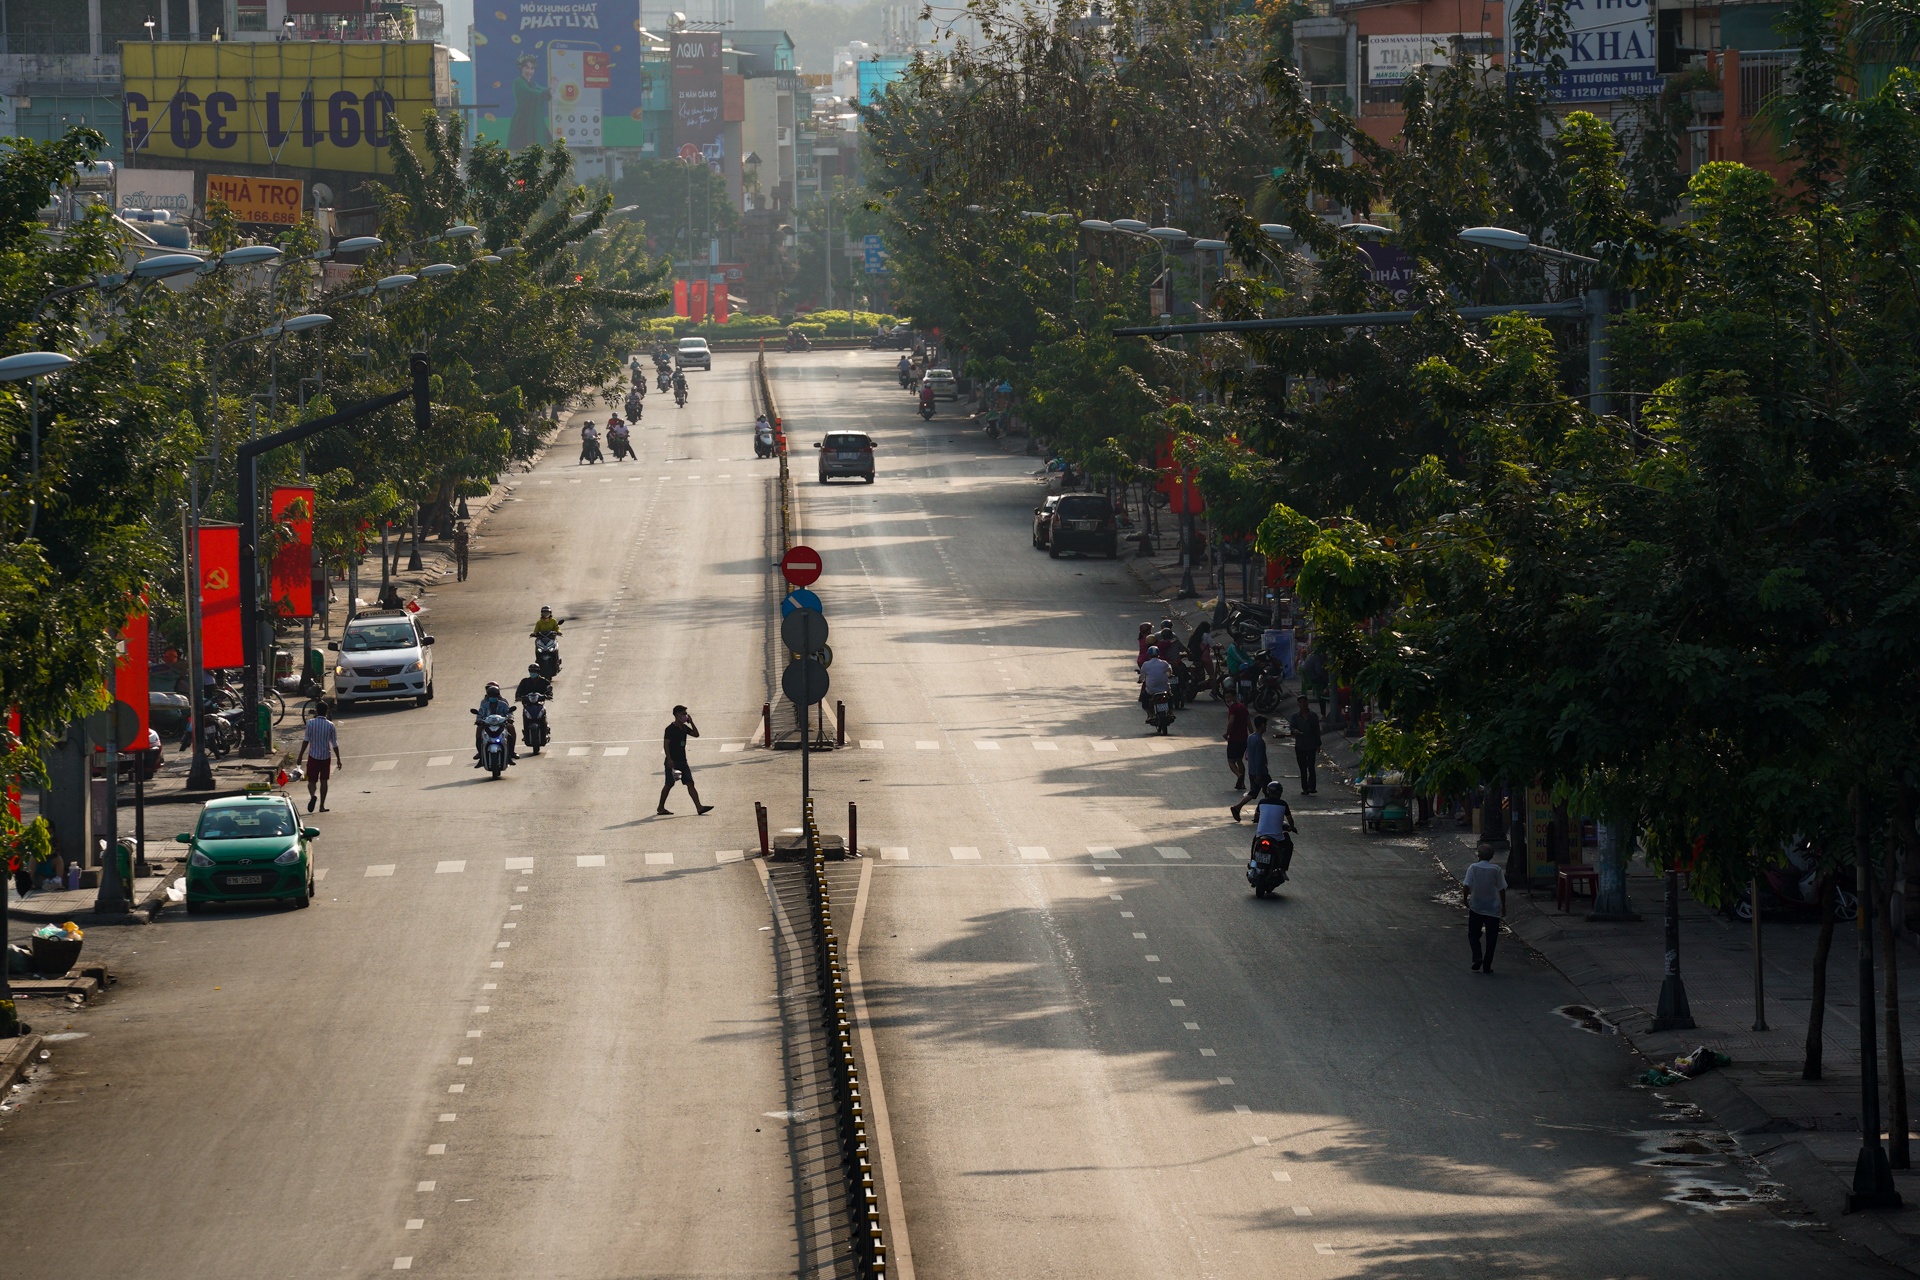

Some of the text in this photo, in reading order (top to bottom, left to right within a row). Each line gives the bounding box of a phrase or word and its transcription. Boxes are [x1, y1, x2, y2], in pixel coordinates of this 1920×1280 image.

[537, 4, 570, 13] KHUNG
[572, 3, 597, 12] CHAT
[520, 12, 599, 30] PHÁT LÌ XÌ
[676, 43, 704, 57] AQUA
[121, 191, 188, 209] SẤY KHÔ
[210, 178, 299, 210] NHÀ TRỌ
